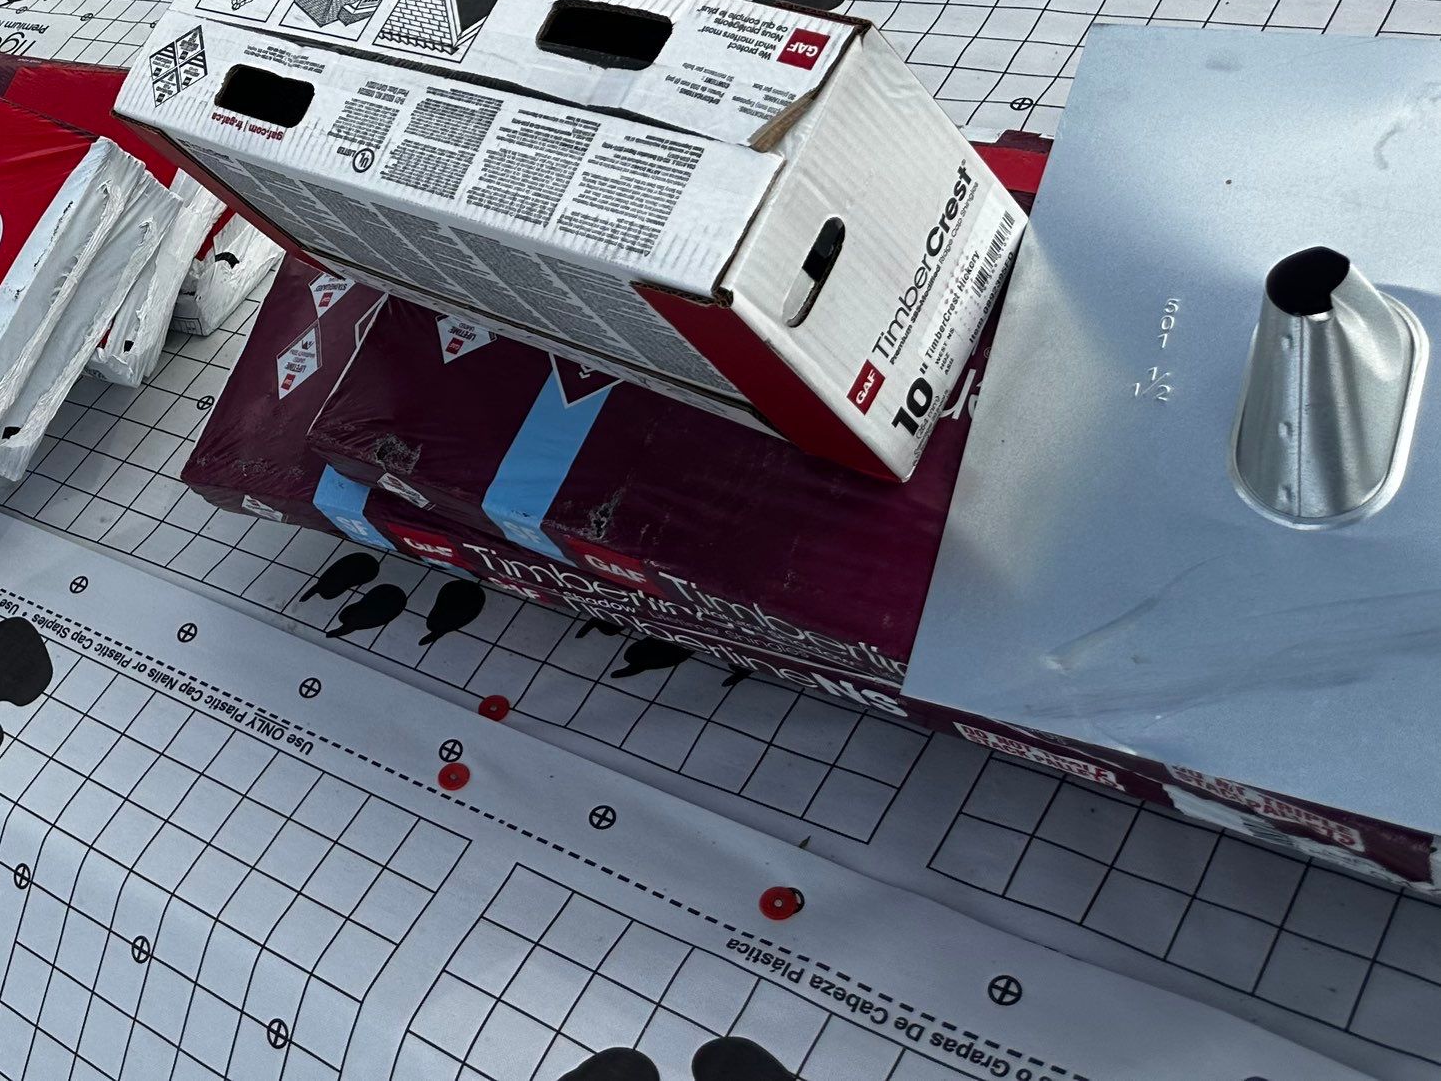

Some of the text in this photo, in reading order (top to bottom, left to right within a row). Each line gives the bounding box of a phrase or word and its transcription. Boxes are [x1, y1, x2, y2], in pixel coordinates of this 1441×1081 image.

[4, 20, 50, 34] Premium
[713, 17, 785, 42] Nous protégeons
[727, 12, 760, 26] compte
[760, 20, 776, 30] qui
[721, 31, 756, 45] matters
[726, 42, 759, 57] protect
[754, 40, 778, 51] what
[786, 39, 819, 57] GAF
[210, 111, 283, 142] gaf.com fr.gaf.ca
[335, 145, 356, 157] LISTED
[888, 181, 980, 365] Premium SBS-Modified Ridge Cap Shingles
[855, 370, 877, 406] GAF
[871, 164, 973, 359] TimberCrest
[924, 291, 961, 359] TimberCrest
[956, 250, 981, 292] Hickory
[447, 324, 477, 341] LIFETIME
[968, 315, 985, 344] Item
[584, 553, 647, 585] GAF
[0, 598, 20, 617] Use
[31, 613, 71, 639] Staples
[70, 629, 95, 651] Cap
[94, 642, 132, 670] Plastic
[132, 660, 147, 674] or
[147, 668, 179, 691] Nails
[178, 681, 203, 702] Cap
[204, 694, 244, 724] Plastic
[245, 713, 288, 742] ONLY
[286, 732, 315, 756] Use
[725, 937, 1033, 1081] o Grapas De Cabeza Plástica
